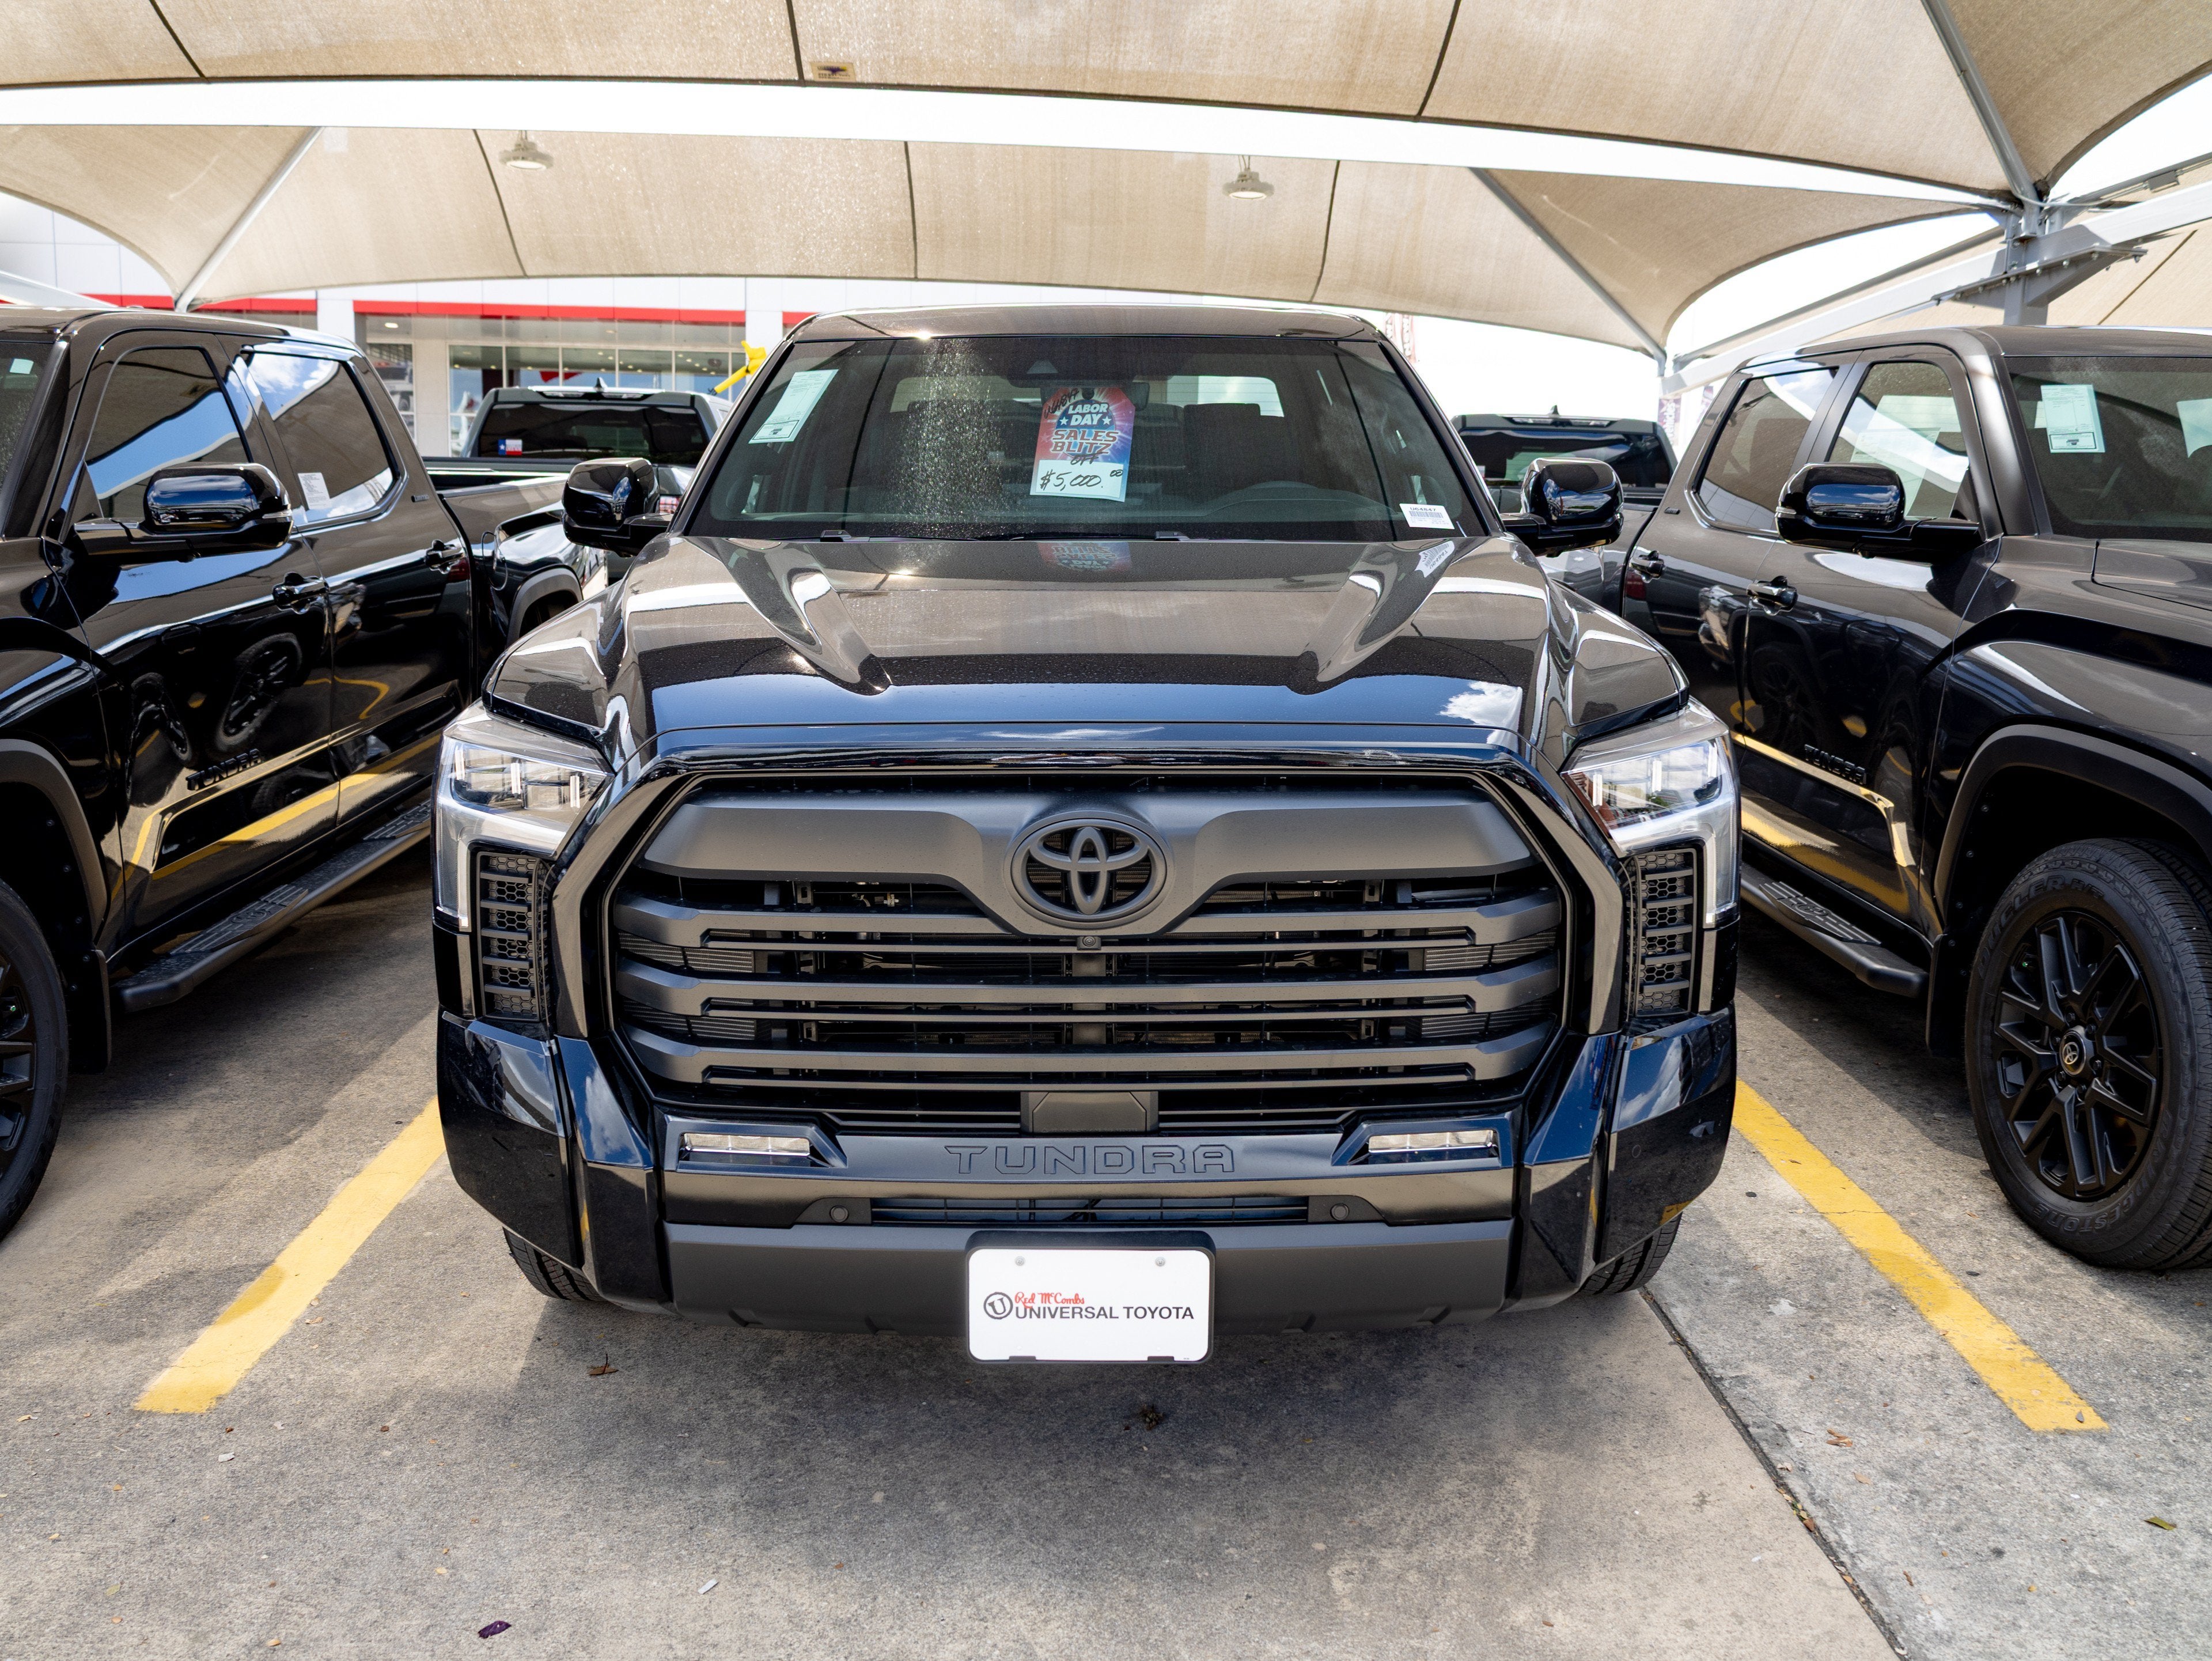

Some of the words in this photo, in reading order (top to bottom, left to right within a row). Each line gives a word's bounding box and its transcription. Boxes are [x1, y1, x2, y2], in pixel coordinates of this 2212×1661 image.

[1068, 403, 1108, 414] LABOR
[1070, 414, 1103, 426] DAY
[1052, 429, 1119, 442] SALES
[1051, 441, 1112, 454] BLITZ
[185, 748, 262, 790] TUNDRA
[944, 1144, 1235, 1175] TUNDRA
[1014, 1292, 1036, 1308] Red
[1037, 1292, 1085, 1304] McCombs
[1015, 1306, 1119, 1319] UNIVERSAL
[1123, 1306, 1194, 1319] TOYOTA
